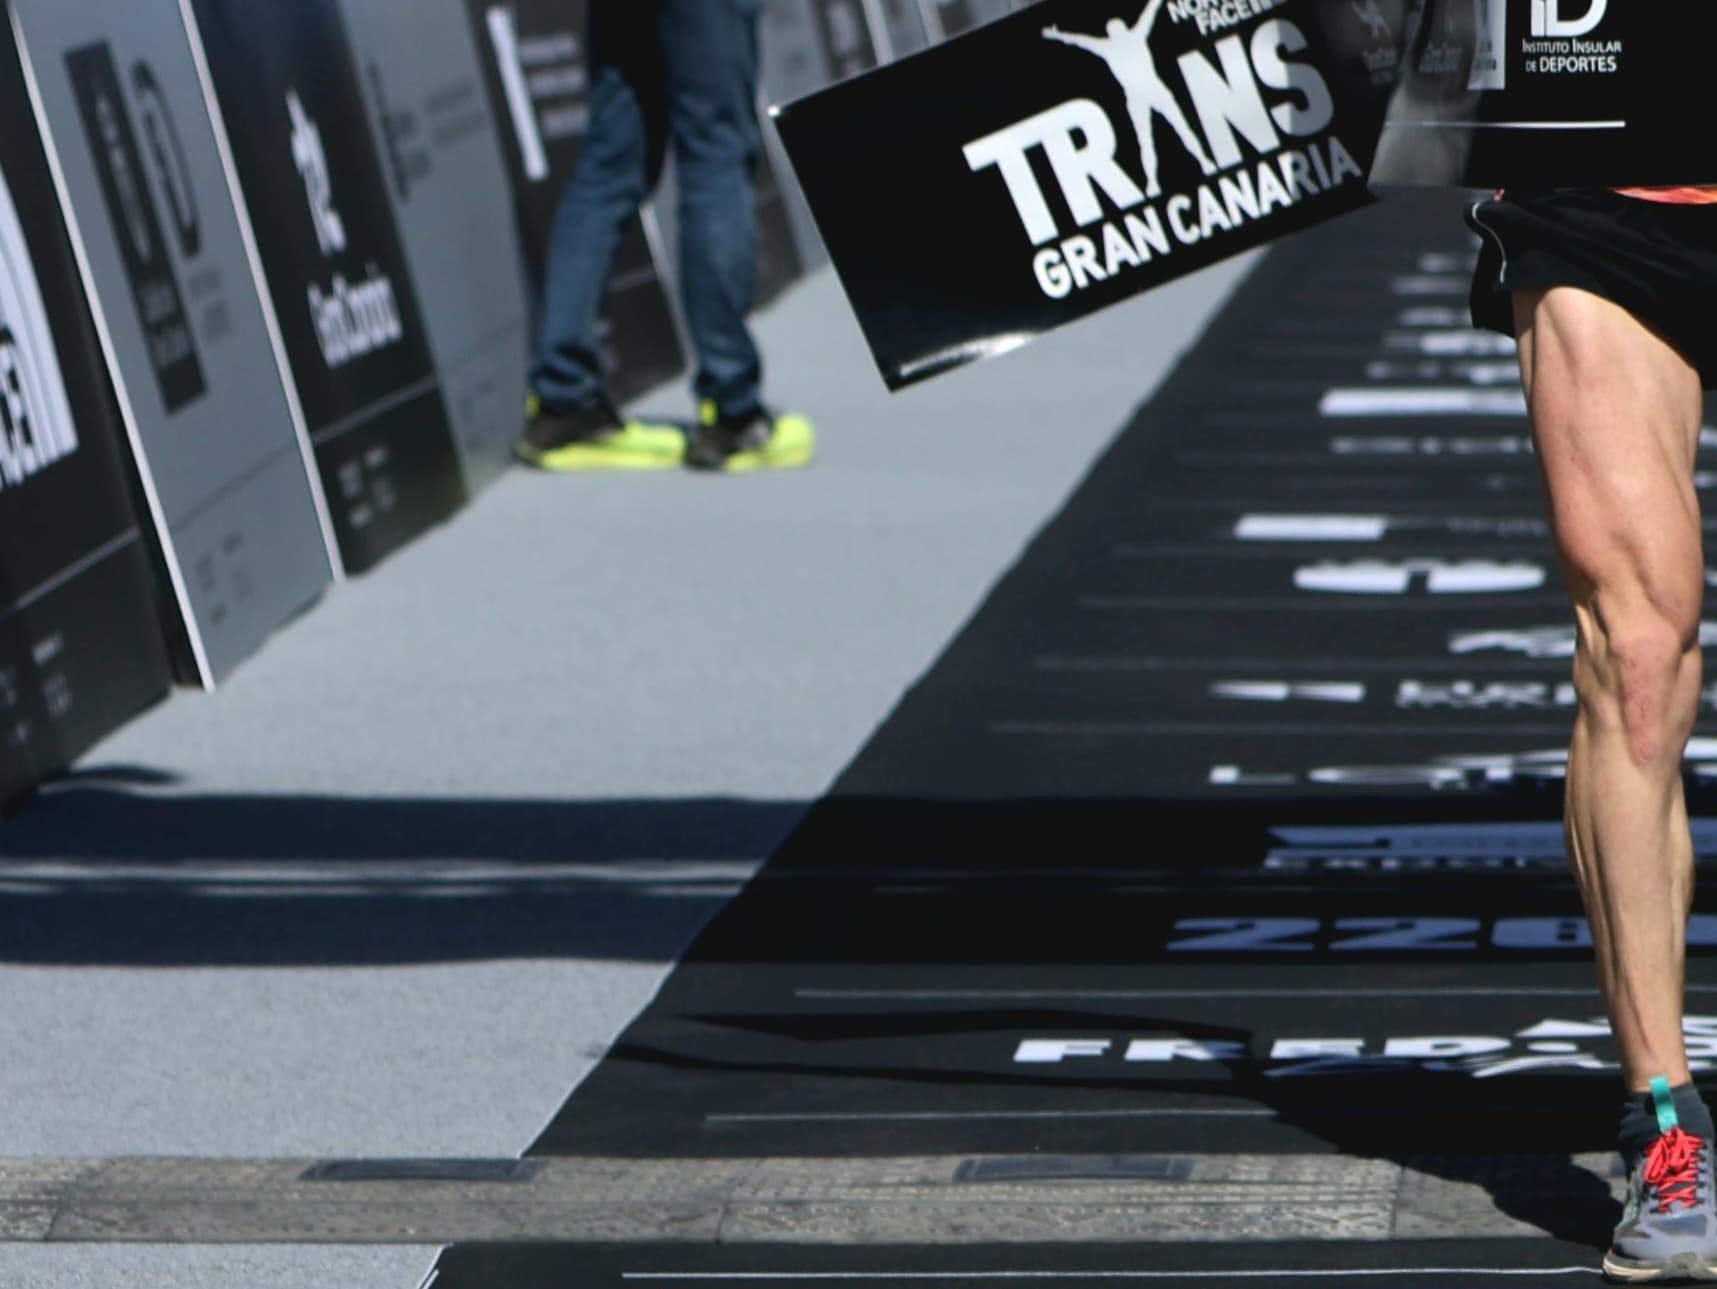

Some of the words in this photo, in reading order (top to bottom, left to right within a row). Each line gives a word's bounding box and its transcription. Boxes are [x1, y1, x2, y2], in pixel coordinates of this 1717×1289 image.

[1522, 38, 1569, 53] INSTITUTO
[1572, 37, 1622, 54] INSULAR
[1539, 55, 1617, 73] DEPORTES
[1033, 205, 1171, 300] GRAN
[1167, 135, 1363, 246] CANARIA
